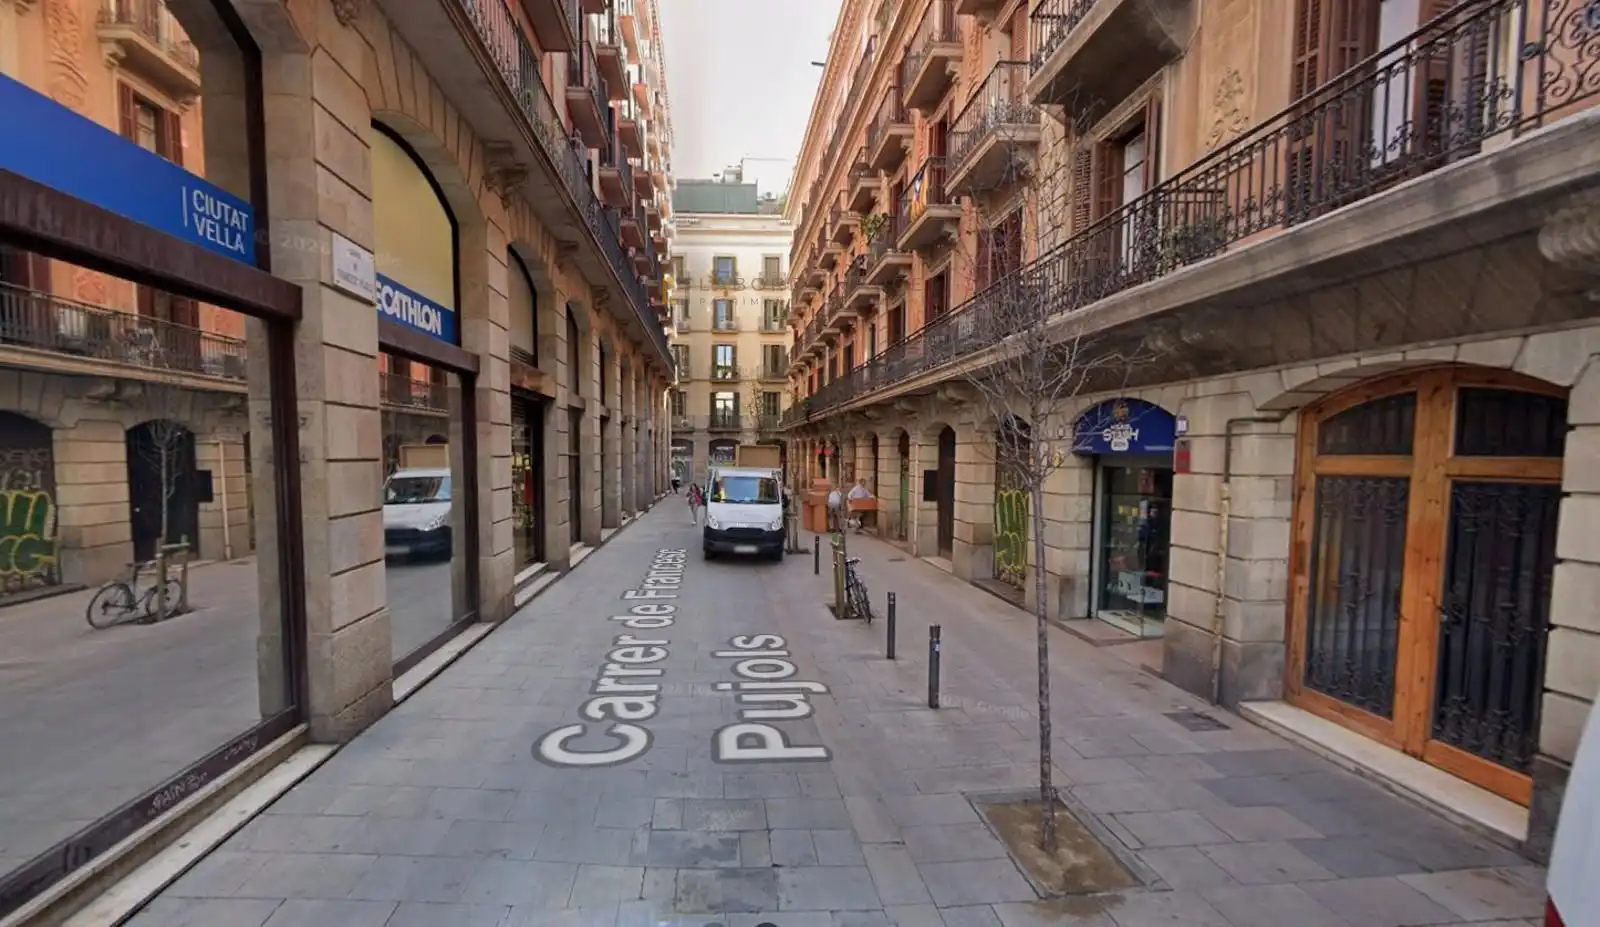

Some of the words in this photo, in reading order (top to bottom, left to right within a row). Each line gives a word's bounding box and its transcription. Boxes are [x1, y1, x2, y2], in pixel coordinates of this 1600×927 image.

[193, 189, 249, 232] CIUTAT
[192, 212, 245, 255] VELLA
[376, 280, 442, 336] ECATHLON
